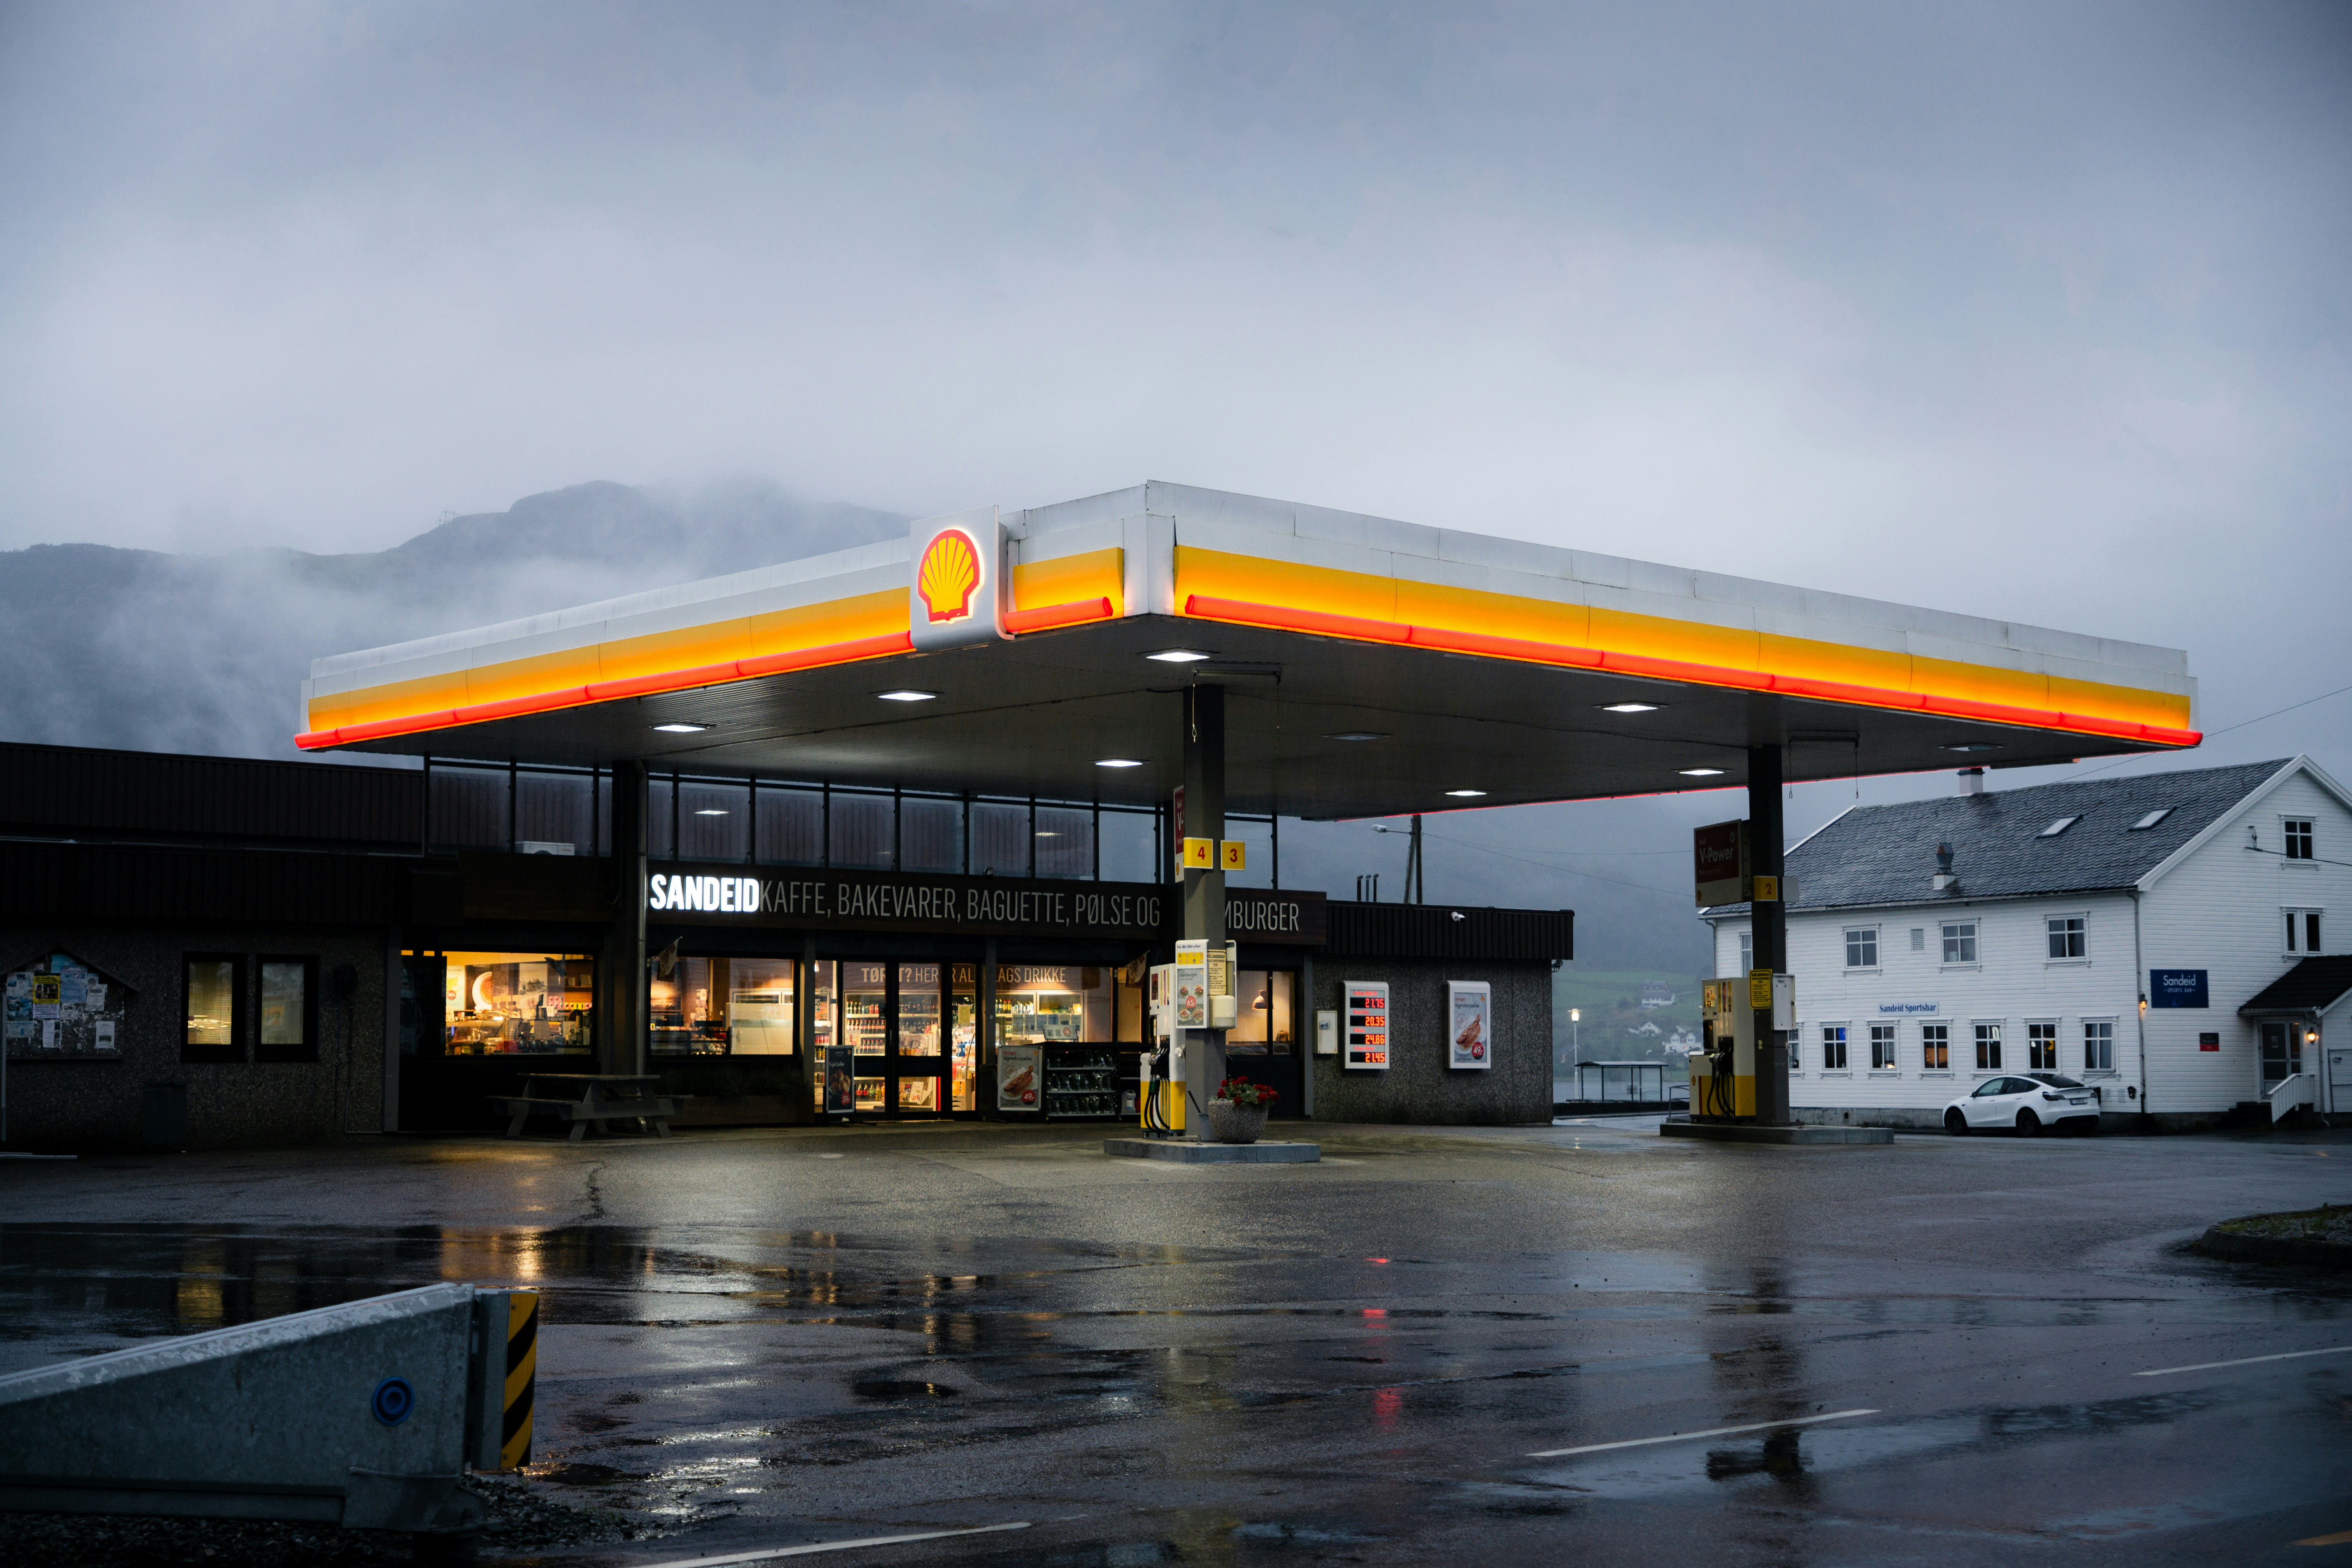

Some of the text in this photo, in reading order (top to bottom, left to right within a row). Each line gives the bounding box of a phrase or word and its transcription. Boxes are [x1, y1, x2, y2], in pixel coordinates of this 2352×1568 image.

[1198, 847, 1205, 860] 4
[1230, 848, 1238, 862] 3
[1700, 847, 1733, 864] V-Power
[650, 874, 759, 913] SANDEID
[1766, 883, 1772, 895] 2
[760, 880, 831, 918] KAFFE,
[838, 884, 961, 923] BAKEVARER,
[967, 889, 1069, 926] BAGUETTE,
[1075, 893, 1131, 925] PØLSE
[1136, 897, 1159, 926] OG
[915, 968, 938, 982] HER
[1024, 967, 1066, 983] DRIKKE
[2163, 974, 2196, 986] Sandeid
[1365, 998, 1384, 1008] 21.75
[1880, 1004, 1936, 1013] Sandeid Sportsbar
[1365, 1016, 1385, 1026] 20.35
[1365, 1034, 1385, 1044] 24.86
[1473, 1046, 1483, 1055] 49,-
[1365, 1052, 1385, 1063] 21.45
